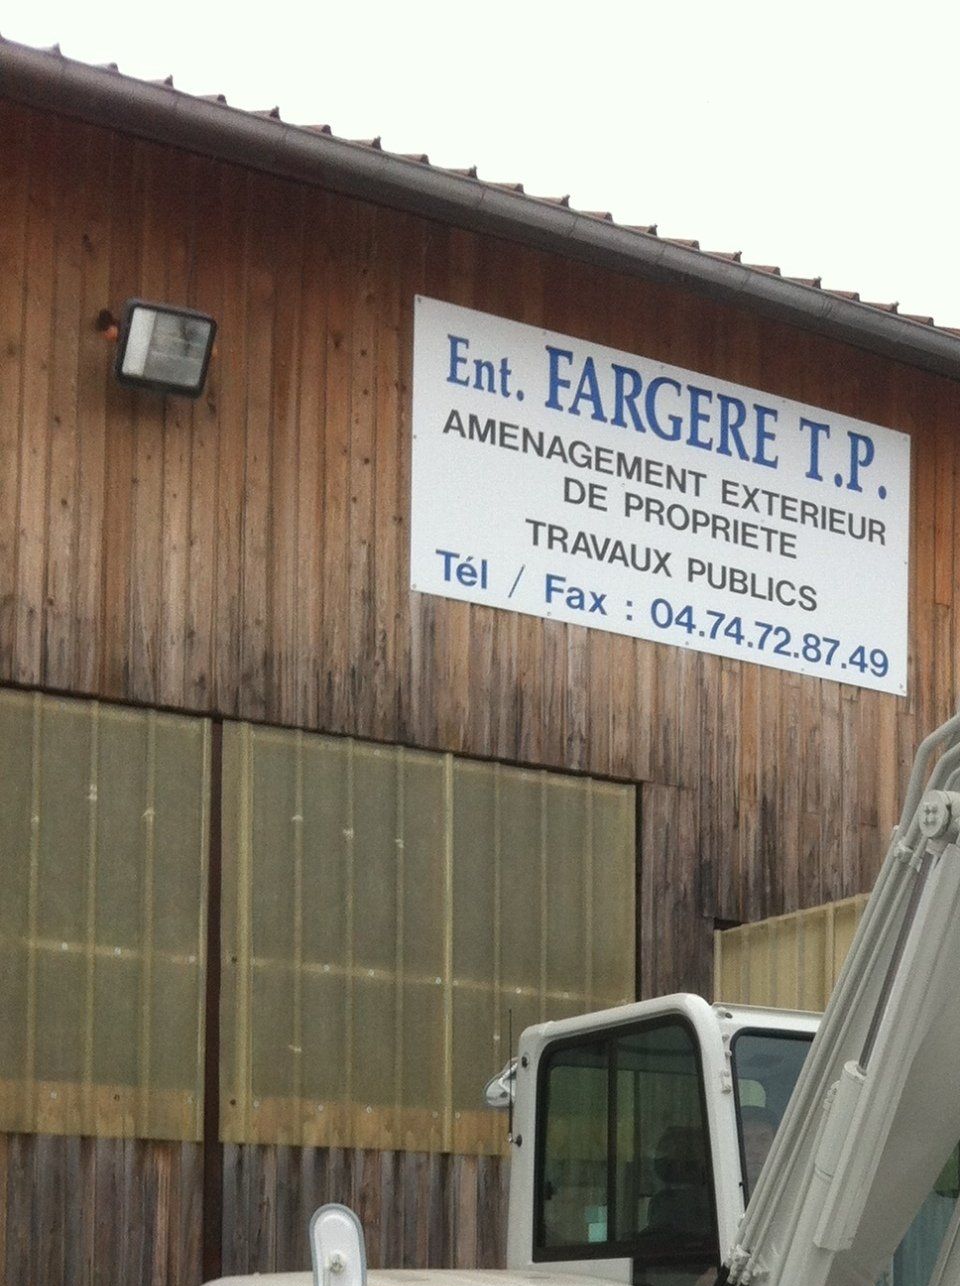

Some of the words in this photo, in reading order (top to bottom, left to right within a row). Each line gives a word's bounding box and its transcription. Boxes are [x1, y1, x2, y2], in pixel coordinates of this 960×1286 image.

[443, 409, 708, 498] AMENAGEMENT
[721, 479, 887, 547] EXTERIEUR
[446, 333, 525, 402] Ent.
[544, 345, 780, 469] FARGERE
[800, 417, 889, 501] T.P.
[525, 519, 672, 578] TRAVAUX
[688, 557, 819, 613] PUBLICS
[564, 477, 609, 512] DE
[624, 493, 798, 560] PROPRIETE
[435, 549, 489, 590] Tél
[507, 565, 525, 598] /
[544, 574, 608, 617] Fax
[625, 598, 635, 621] :
[650, 598, 890, 679] 04.74.72.87.49
